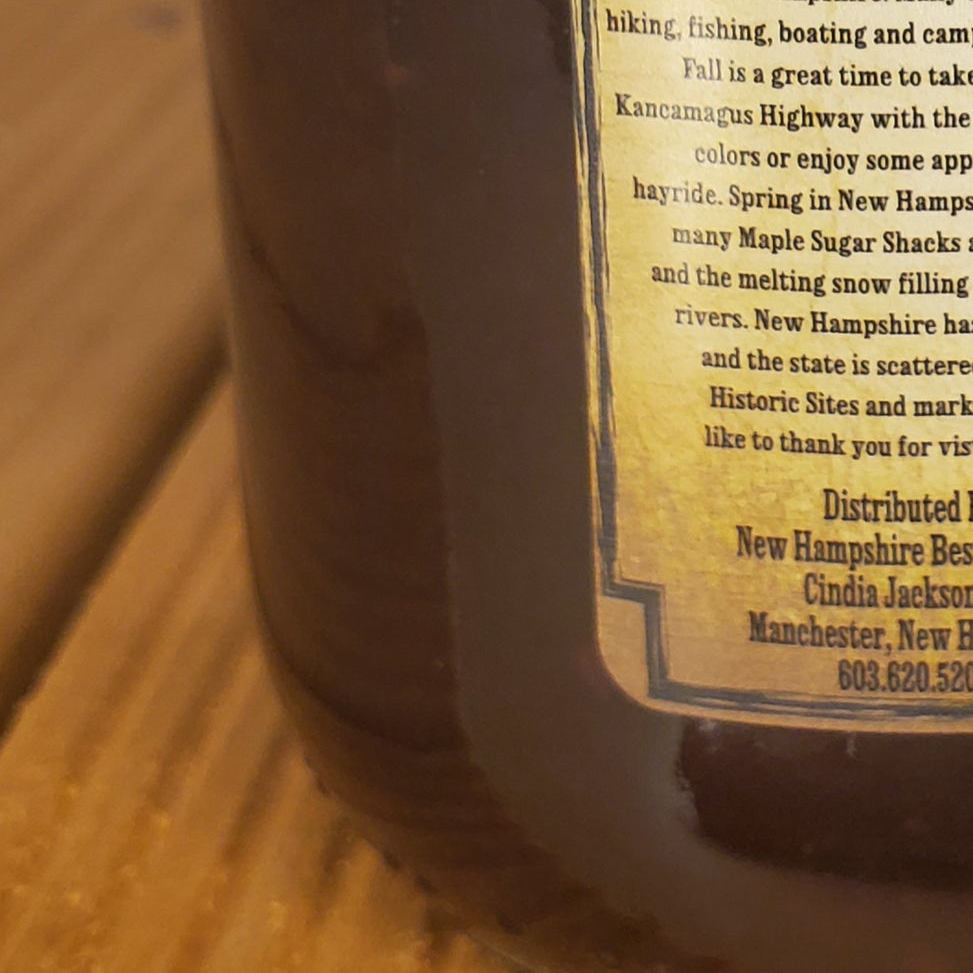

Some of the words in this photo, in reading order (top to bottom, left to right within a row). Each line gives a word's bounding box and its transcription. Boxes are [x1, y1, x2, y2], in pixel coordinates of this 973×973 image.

[606, 8, 681, 41] hiking,
[689, 15, 773, 47] fishing,
[778, 19, 867, 49] boating
[683, 57, 722, 81] Fall
[771, 65, 833, 89] great
[839, 64, 892, 87] time
[615, 92, 753, 128] Kancamagus
[760, 103, 864, 134] Highway
[870, 105, 926, 129] with
[932, 105, 971, 129] the
[695, 142, 760, 167] colors
[797, 147, 860, 175] enjoy
[866, 154, 924, 171] some
[633, 175, 723, 206] hayride.
[729, 184, 804, 215] Spring
[838, 189, 890, 212] New
[672, 228, 732, 251] many
[738, 226, 805, 255] Maple
[811, 229, 877, 257] Sugar
[883, 230, 961, 253] Shacks
[652, 262, 690, 285] and
[738, 268, 826, 297] melting
[832, 277, 892, 294] snow
[899, 272, 969, 298] filling
[675, 304, 748, 329] rivers.
[754, 308, 805, 332] New
[810, 311, 937, 339] Hampshire
[702, 347, 742, 369] and
[747, 348, 783, 372] the
[789, 354, 846, 375] state
[710, 385, 800, 413] Historic
[805, 392, 859, 416] Sites
[865, 394, 907, 417] and
[704, 424, 746, 449] like
[779, 430, 847, 455] thank
[851, 440, 892, 460] you
[897, 435, 933, 457] for
[822, 488, 962, 523] Distributed
[736, 525, 788, 560] New
[793, 529, 924, 571] Hampshire
[803, 573, 879, 607] Cindia
[748, 611, 891, 651] Manchester,
[898, 619, 951, 650] New
